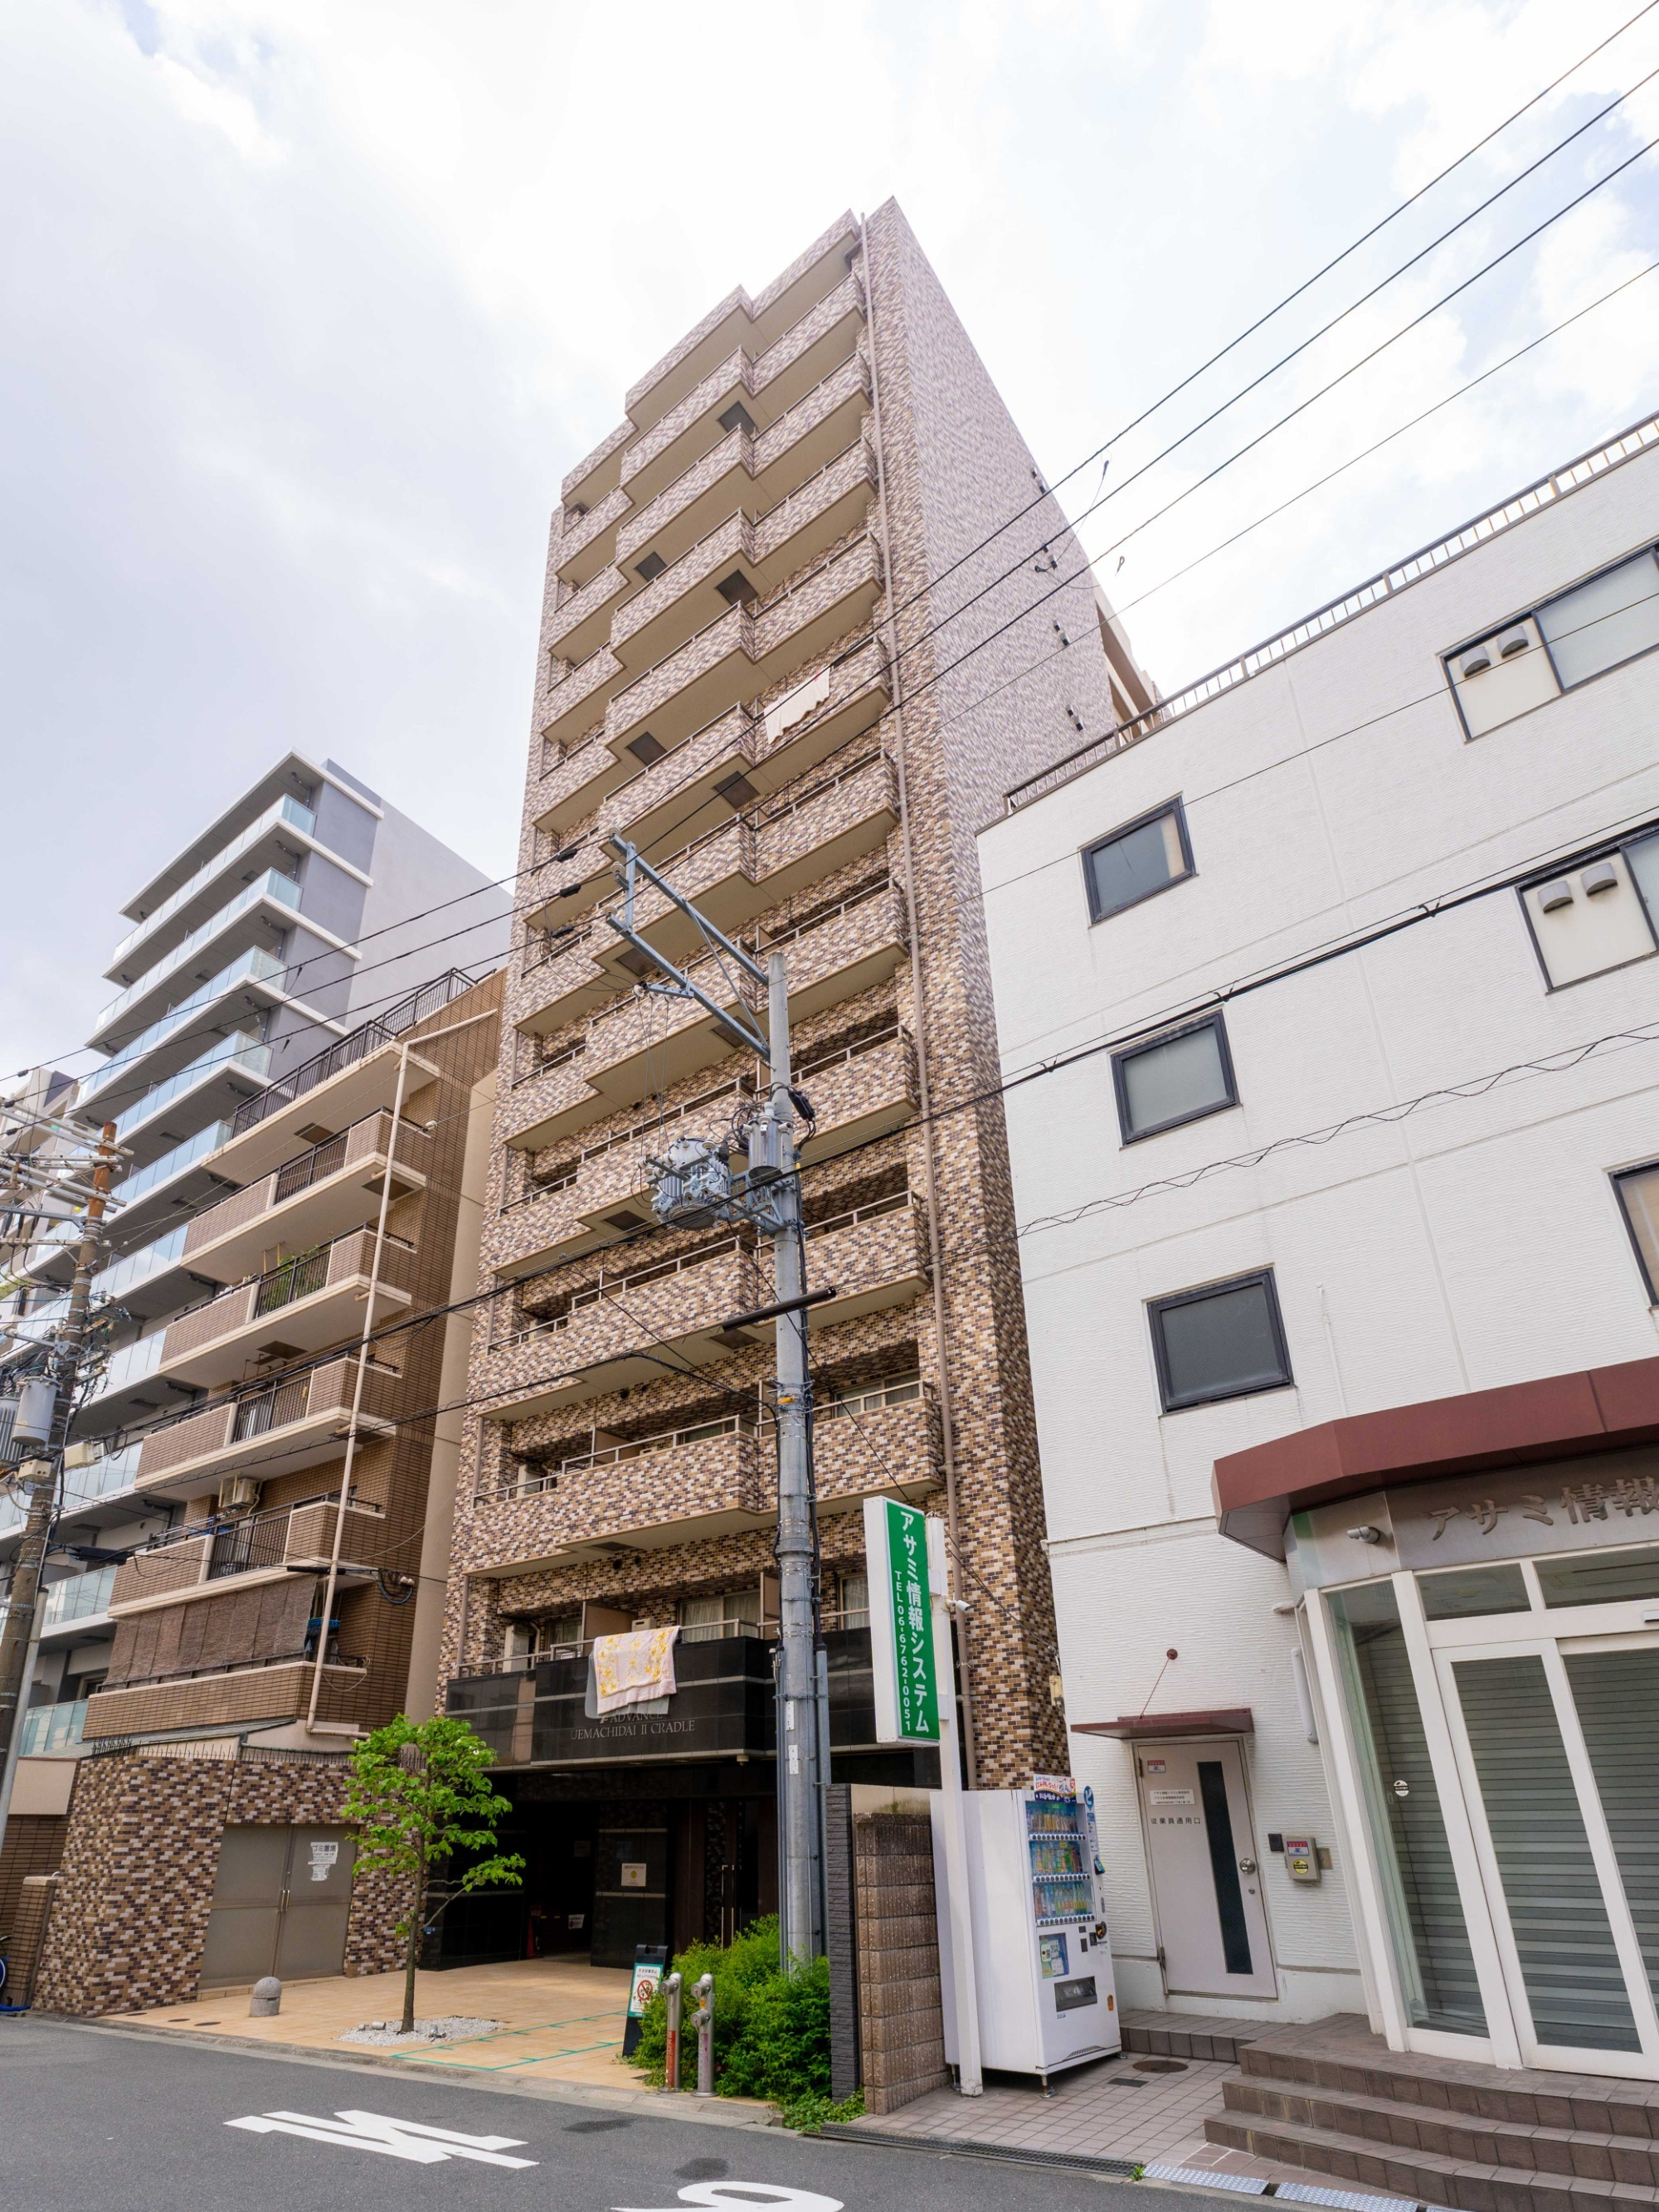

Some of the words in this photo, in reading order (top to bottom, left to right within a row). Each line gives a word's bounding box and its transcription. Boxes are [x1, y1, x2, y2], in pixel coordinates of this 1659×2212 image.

[901, 1511, 929, 1733] アサミ情報システム
[571, 1724, 636, 1740] UEMACHIDAI
[651, 1720, 695, 1734] CRADLE
